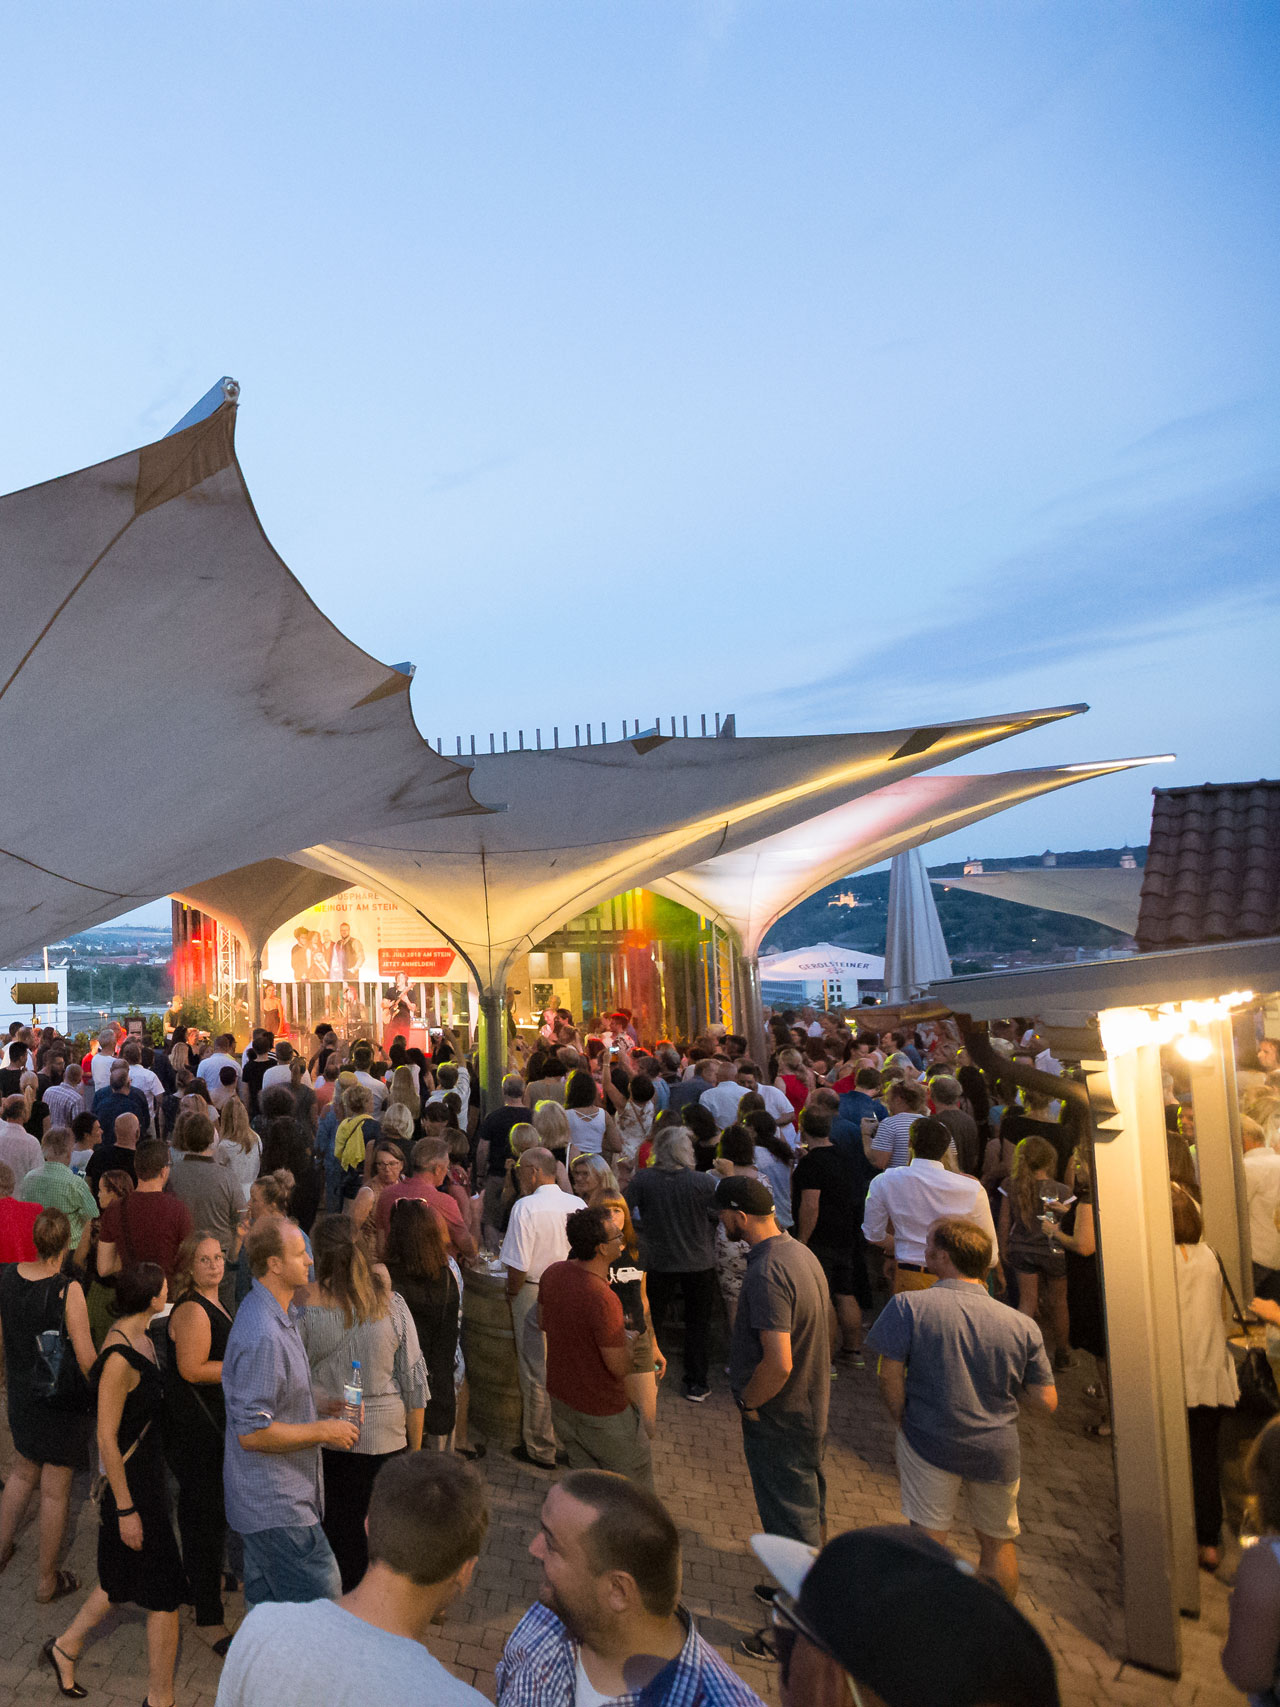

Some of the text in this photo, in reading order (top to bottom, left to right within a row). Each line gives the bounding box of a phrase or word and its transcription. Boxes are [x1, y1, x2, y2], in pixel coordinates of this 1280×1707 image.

[314, 904, 352, 912] WEINGUT
[372, 903, 398, 911] STEIN
[798, 961, 870, 970] GEROLSTEINER
